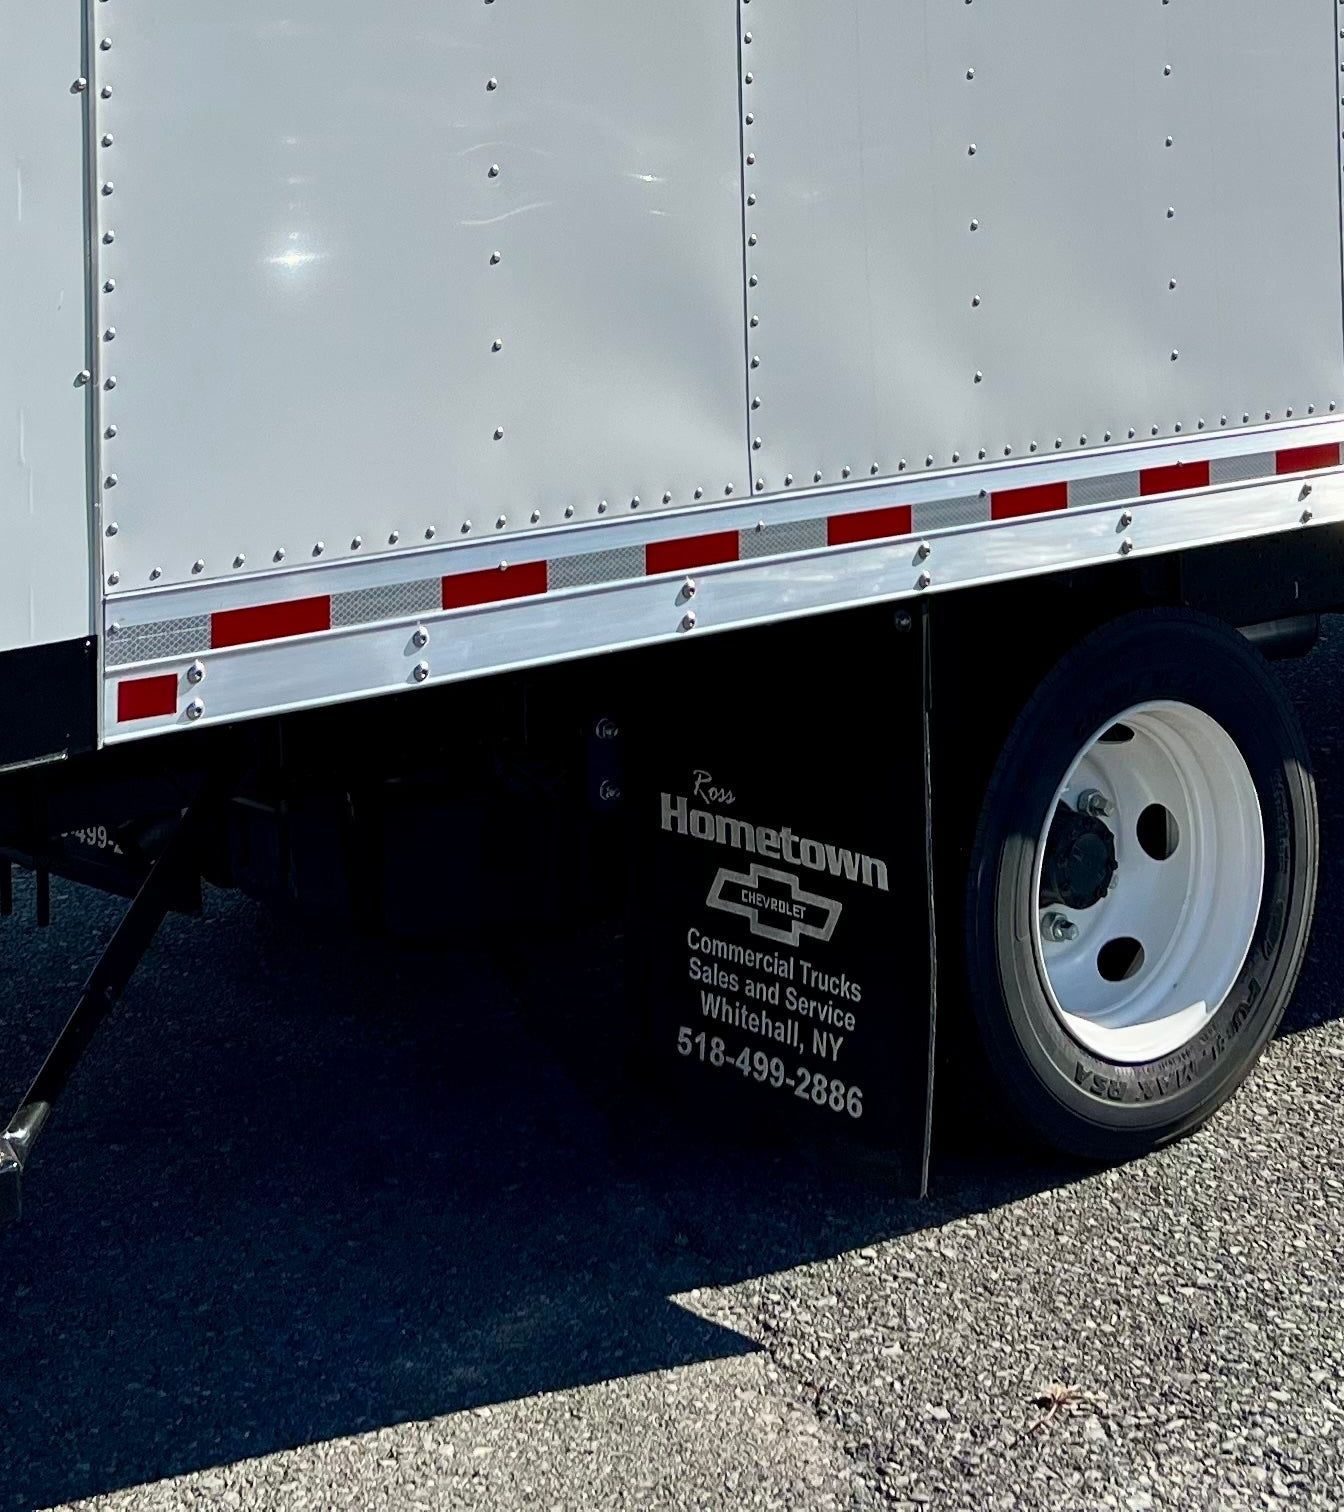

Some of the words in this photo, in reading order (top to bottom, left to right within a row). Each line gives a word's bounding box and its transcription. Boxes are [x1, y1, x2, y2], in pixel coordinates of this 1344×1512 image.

[692, 769, 736, 805] Ross
[660, 791, 890, 892] Hometown
[741, 888, 807, 920] CHEVROLET
[687, 927, 794, 981] Commercial
[799, 959, 862, 1003] Trucks
[688, 956, 740, 992] Sales
[744, 977, 780, 1006] and
[785, 986, 856, 1033] Service
[700, 990, 804, 1055] Whitehall,
[812, 1027, 844, 1063] NY
[677, 1026, 863, 1119] 518-499-2886
